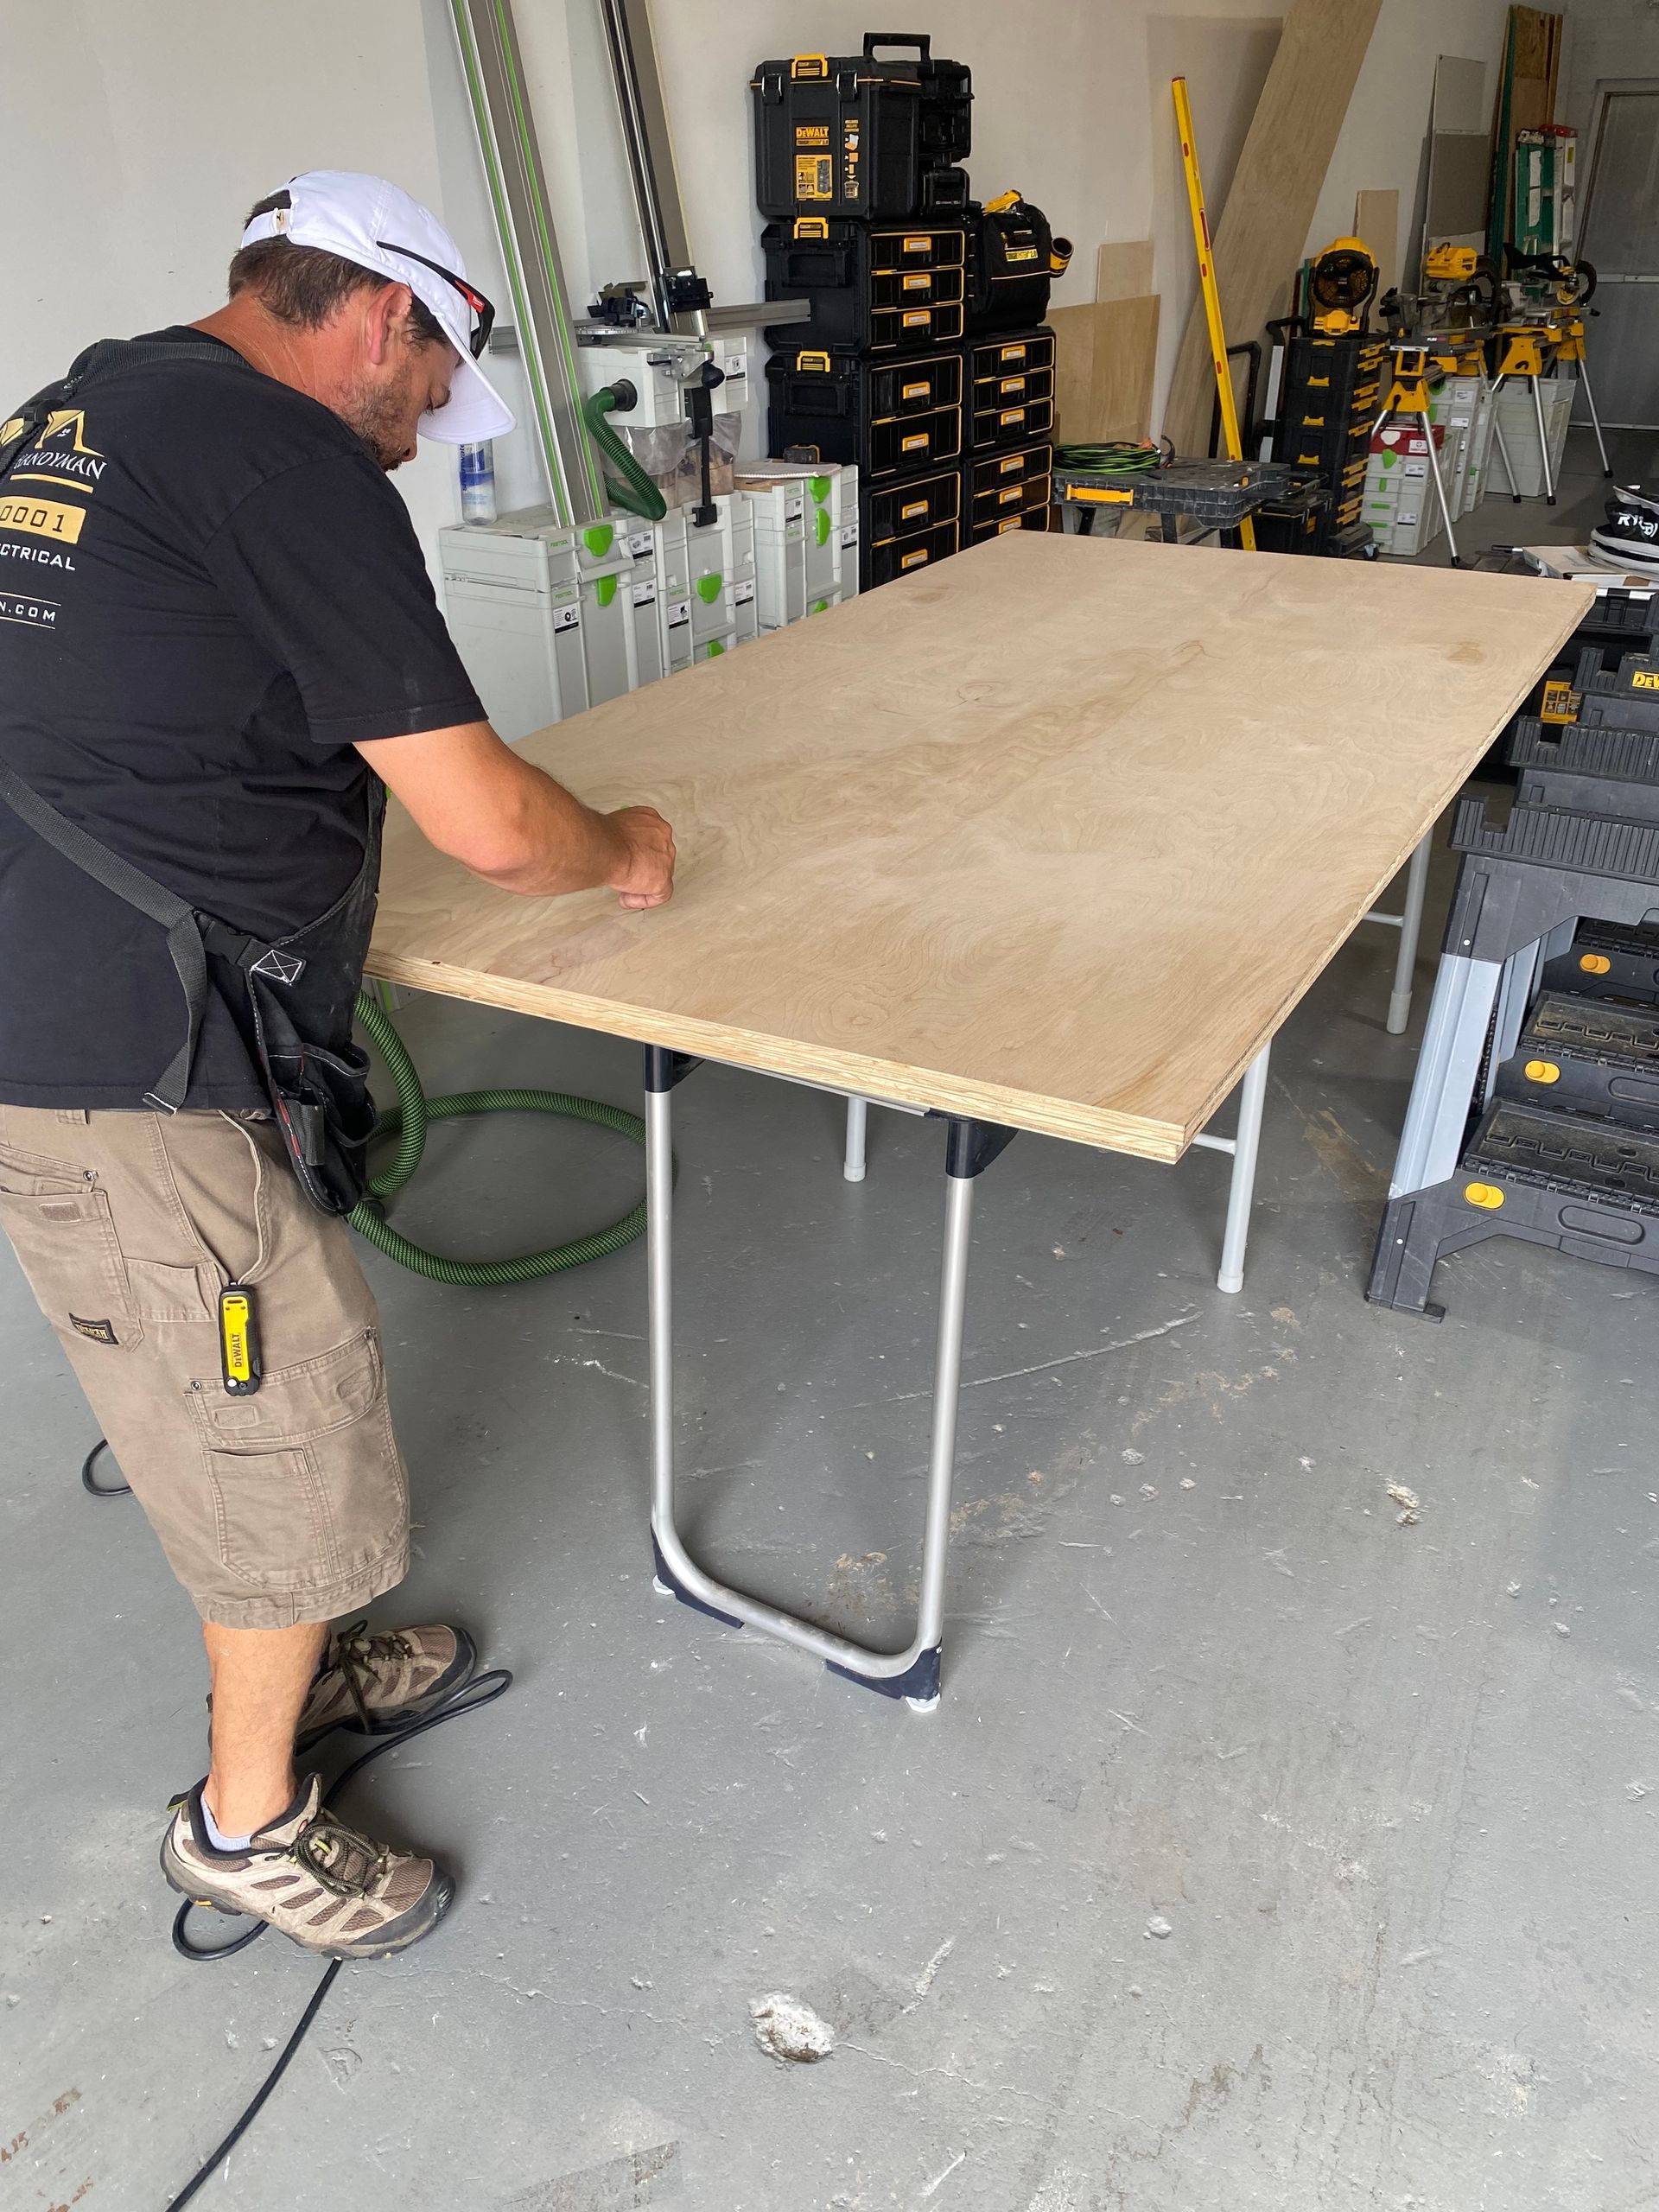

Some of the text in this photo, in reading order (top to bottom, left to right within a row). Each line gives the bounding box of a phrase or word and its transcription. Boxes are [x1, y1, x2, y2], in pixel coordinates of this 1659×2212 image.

[0, 505, 65, 533] 0001
[0, 543, 76, 571] CTRICAL
[232, 1333, 242, 1368] DEWALT
